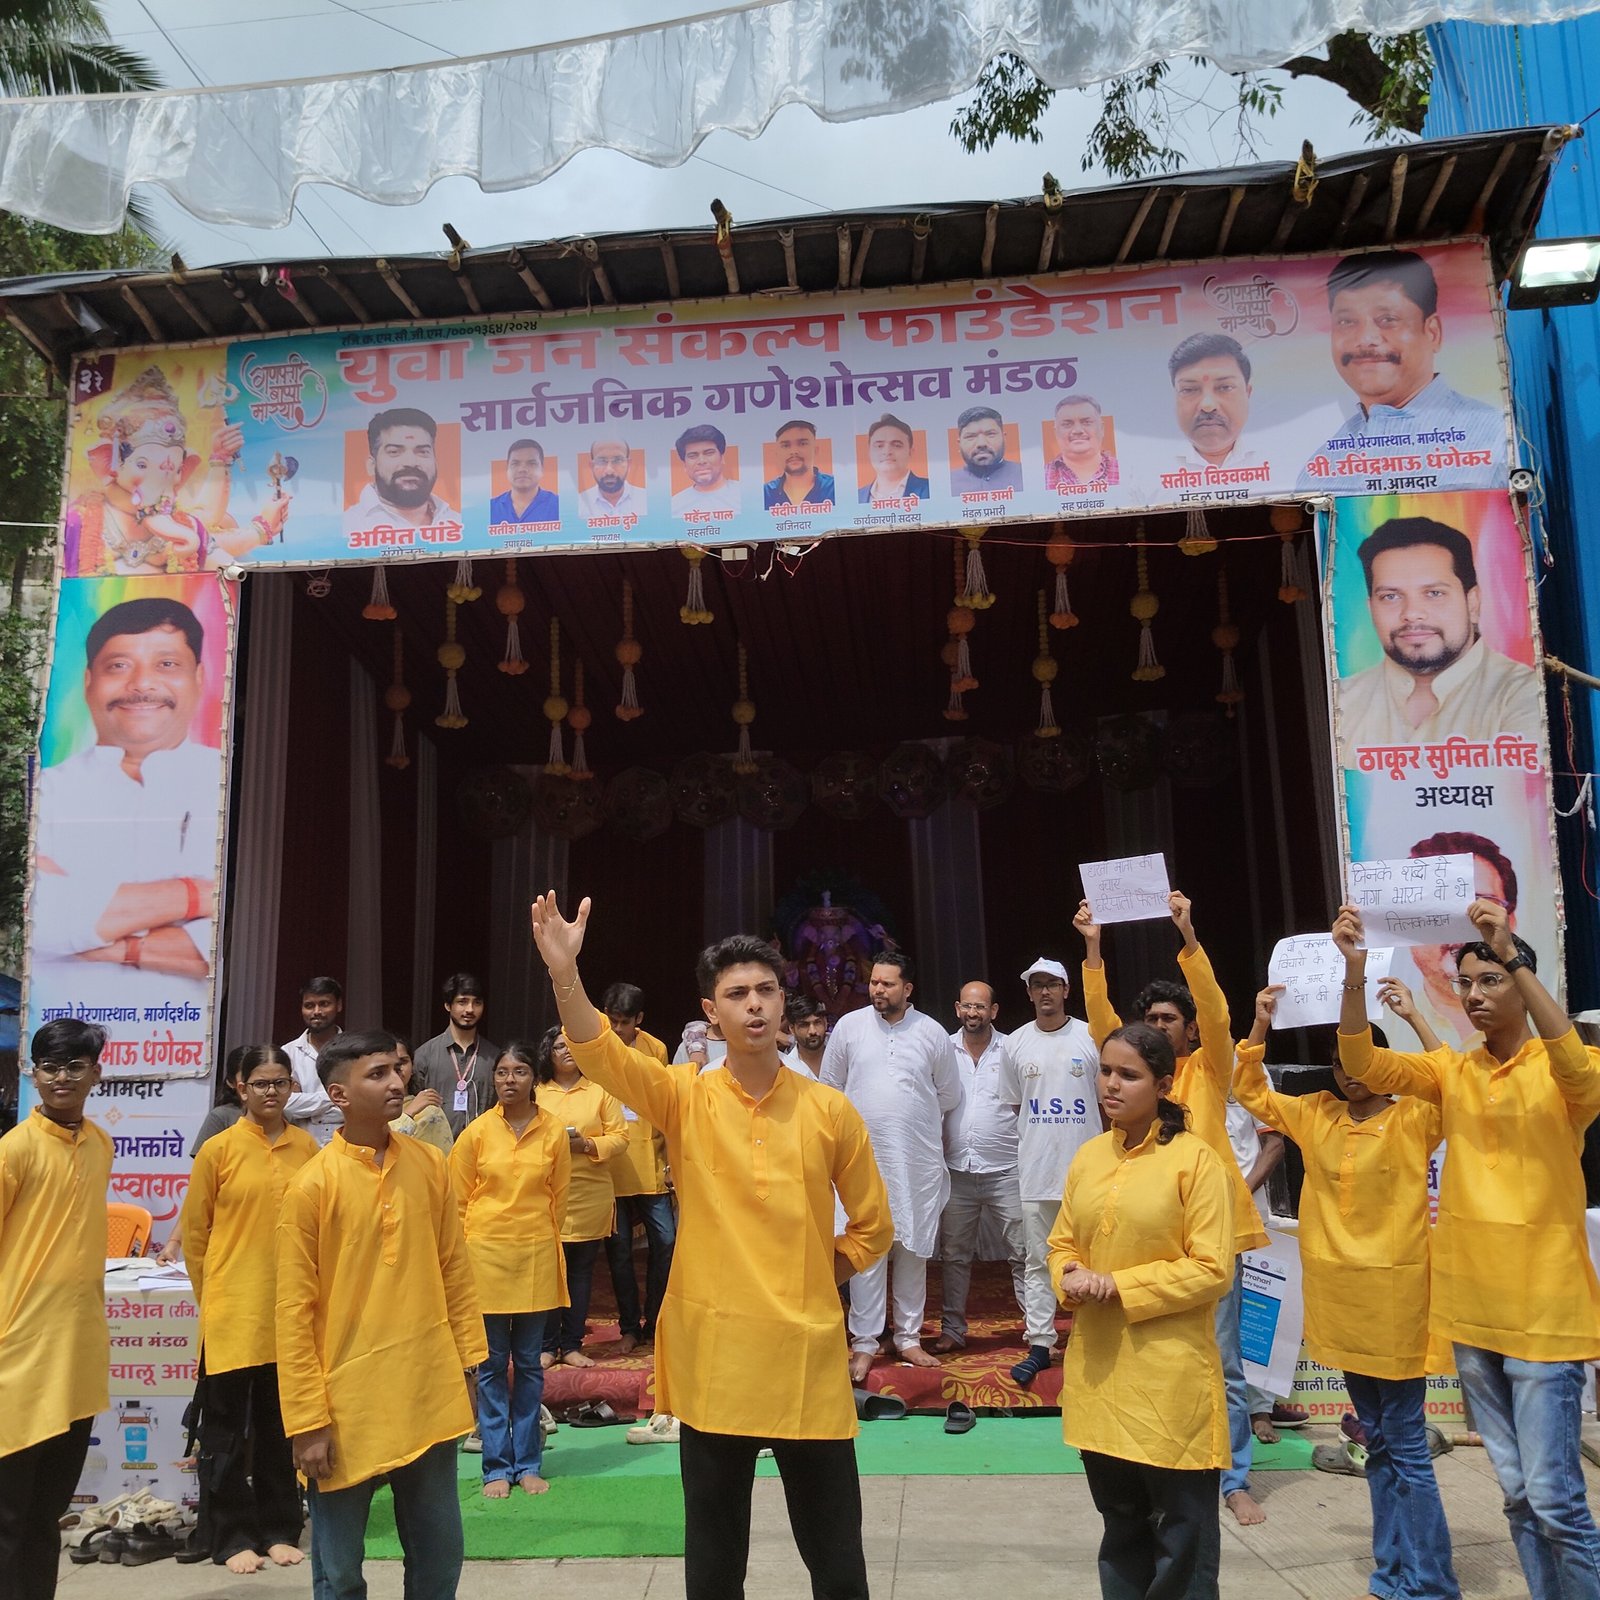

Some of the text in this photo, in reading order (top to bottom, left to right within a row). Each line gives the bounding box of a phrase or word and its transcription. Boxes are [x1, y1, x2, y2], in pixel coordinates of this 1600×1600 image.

[340, 285, 1182, 404] युवा जन संकल्प फाउंडेशन
[460, 349, 1078, 432] सार्वजनिक गणेशोत्सव मंडळ
[1327, 433, 1355, 451] आमचे
[1417, 427, 1466, 444] मार्गदर्शक
[1307, 446, 1492, 477] श्री.रविंद्रभाऊ धंगेकर
[1160, 461, 1270, 488] सतीश विश्वकर्मा
[1365, 475, 1438, 491] मा.आमदार
[961, 487, 1014, 504] श्याम शर्मा
[1056, 481, 1109, 497] दिपक गोरे
[770, 500, 832, 517] संदीप तिवारी
[871, 493, 919, 512] आनंद दुबे
[1061, 502, 1075, 512] सह
[588, 514, 638, 530] अशोक दुबे
[711, 510, 734, 521] पाल
[899, 513, 922, 524] सदस्य
[349, 520, 462, 547] अमित पांडे
[488, 521, 561, 535] सतीश उपाध्याय
[687, 526, 721, 538] सहसचिव
[776, 520, 812, 531] खजिनदार
[1357, 735, 1538, 780] ठाकूर सुमित सिंह
[1415, 785, 1494, 808] अध्यक्ष
[1354, 889, 1382, 906] जागा
[1392, 886, 1423, 904] भारत
[1384, 911, 1426, 931] तिलक
[144, 1001, 201, 1023] मार्गदर्शक
[143, 1028, 204, 1066] धंगेकर
[1245, 1272, 1272, 1285] Prahari
[105, 1297, 164, 1318] ऊंडेशन
[147, 1331, 188, 1347] मंडळ
[1293, 1376, 1324, 1391] खाली
